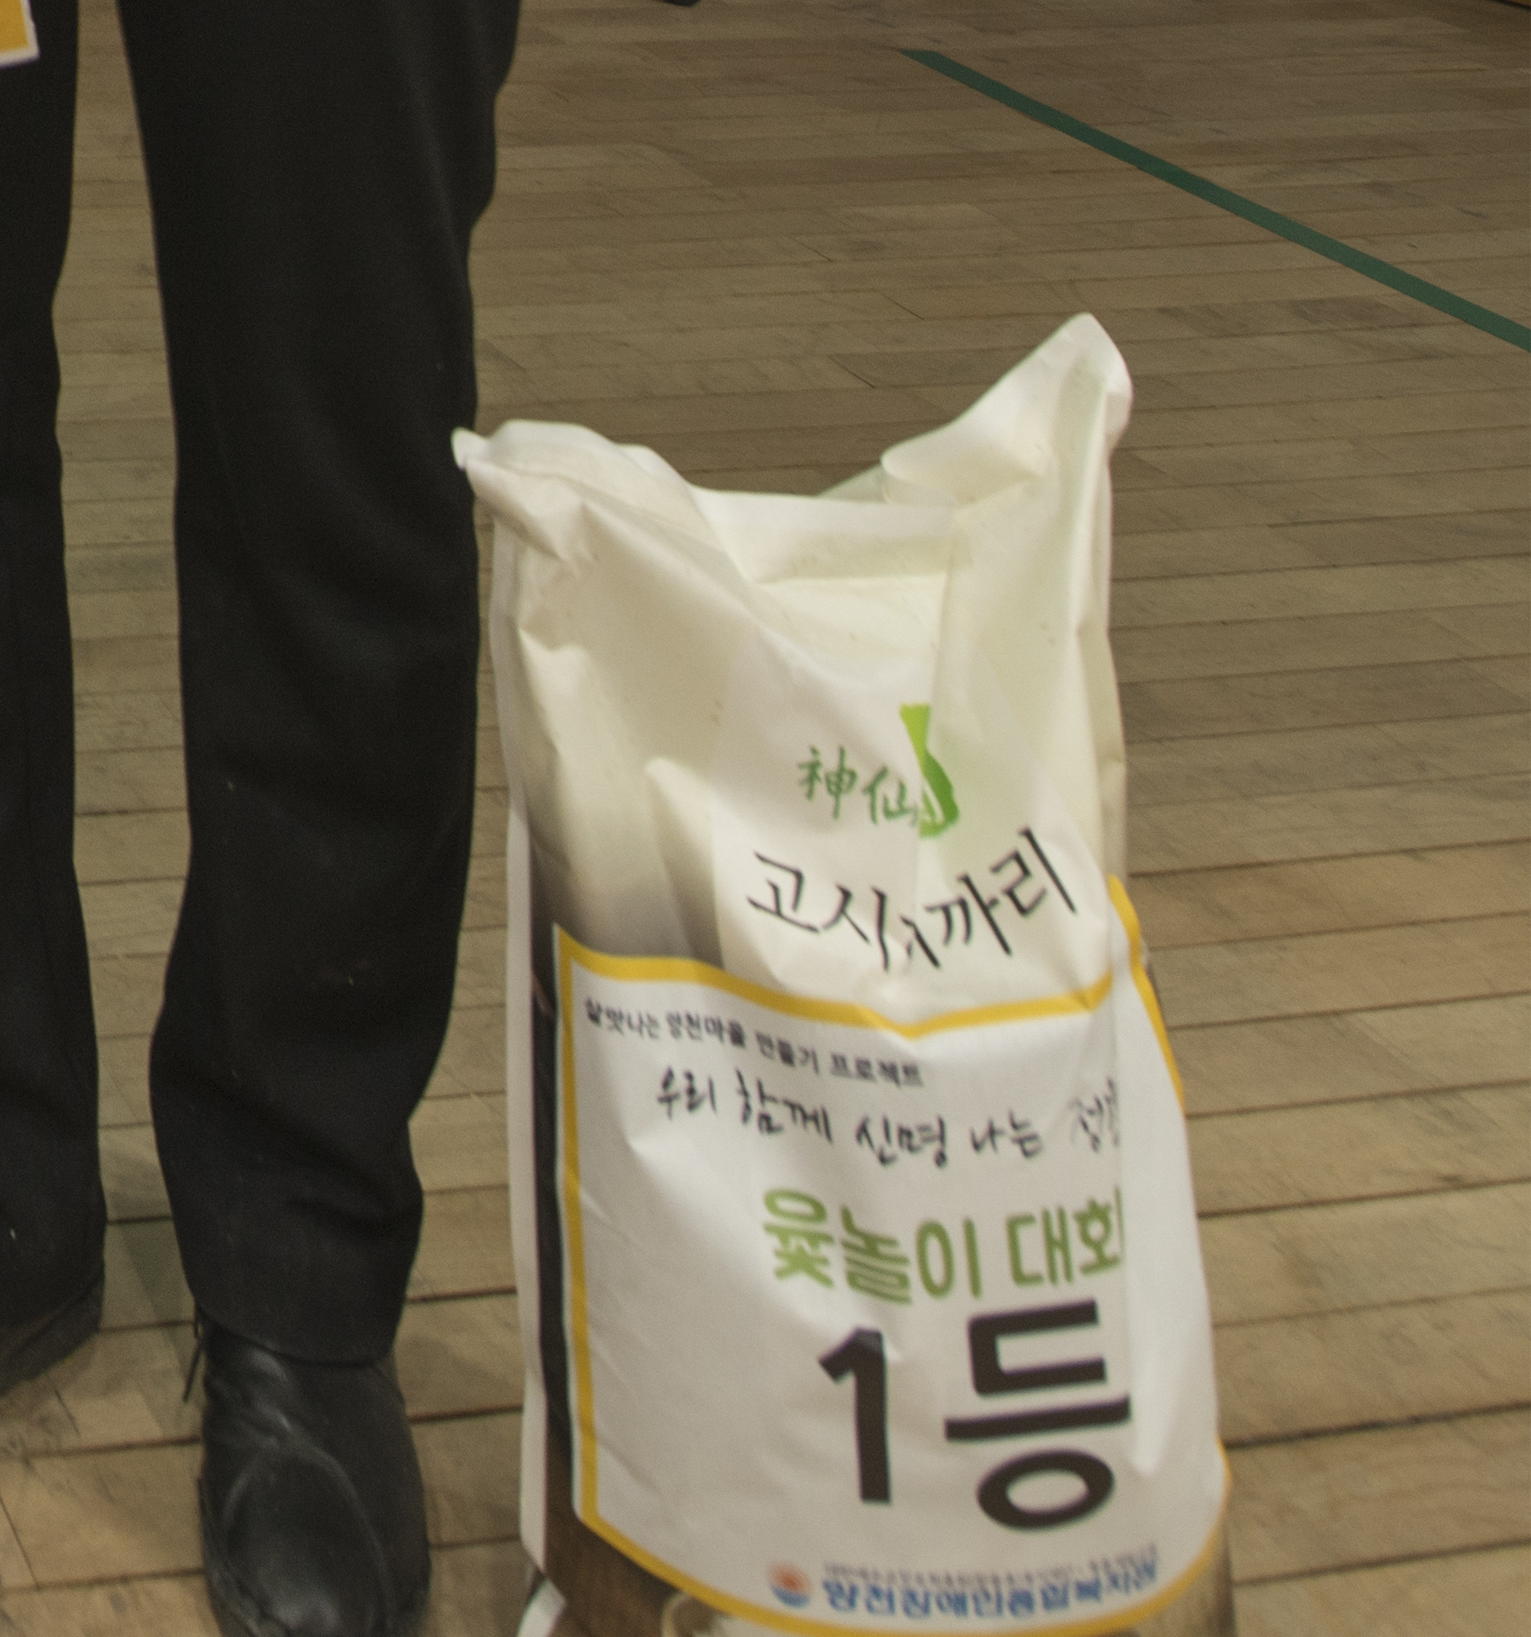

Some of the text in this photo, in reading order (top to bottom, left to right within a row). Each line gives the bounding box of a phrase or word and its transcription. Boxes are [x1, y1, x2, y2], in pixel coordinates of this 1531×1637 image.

[656, 1065, 718, 1121] 우리
[735, 1067, 834, 1145] 함께
[854, 1112, 950, 1169] 신명
[967, 1107, 1043, 1159] 나는
[763, 1187, 1125, 1305] 윷놀이 대회
[817, 1298, 1132, 1531] 1등
